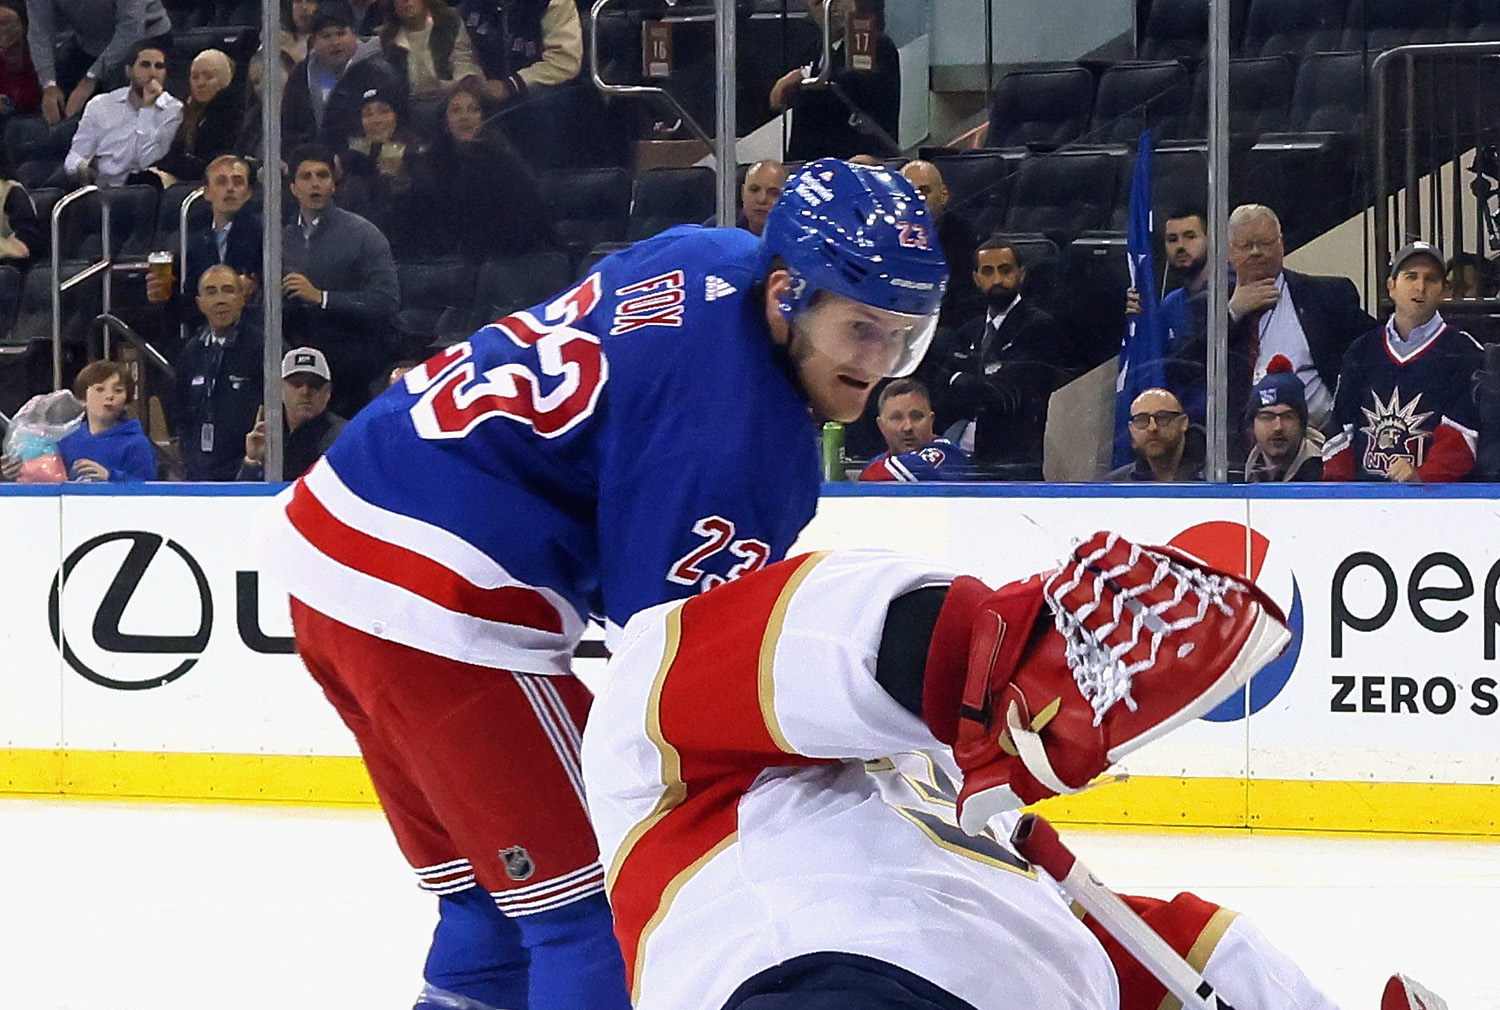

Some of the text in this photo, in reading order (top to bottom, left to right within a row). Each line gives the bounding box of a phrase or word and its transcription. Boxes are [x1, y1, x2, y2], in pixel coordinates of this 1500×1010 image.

[653, 40, 666, 60] 16
[855, 32, 869, 52] 17
[895, 220, 930, 250] 23
[609, 269, 686, 336] FOX
[404, 271, 610, 440] 23
[1330, 675, 1457, 715] ZERO
